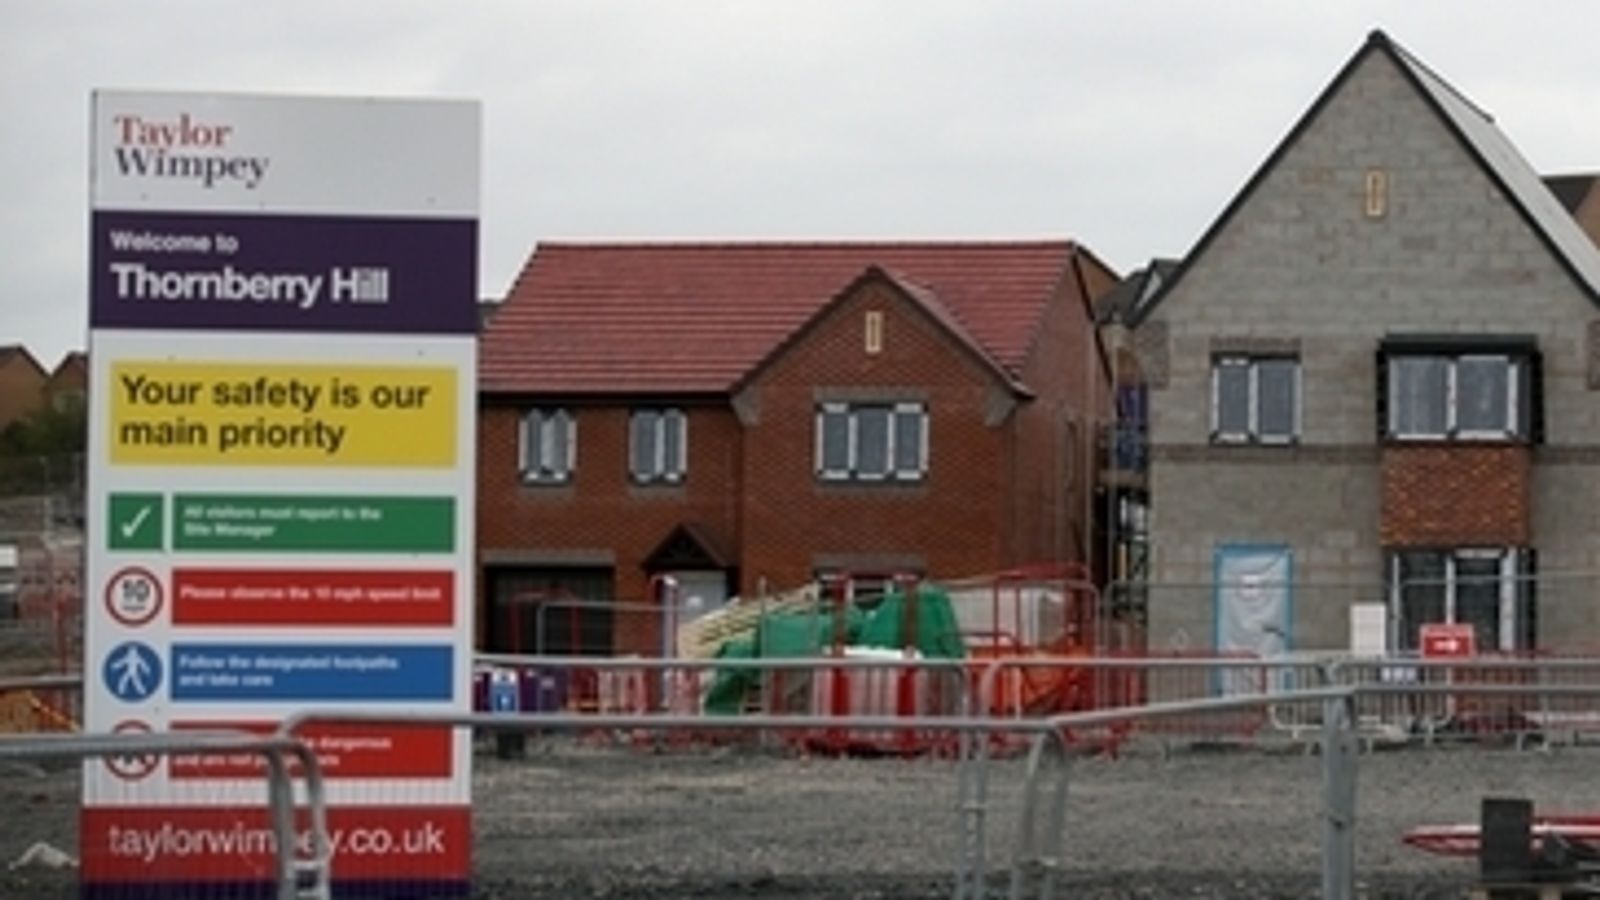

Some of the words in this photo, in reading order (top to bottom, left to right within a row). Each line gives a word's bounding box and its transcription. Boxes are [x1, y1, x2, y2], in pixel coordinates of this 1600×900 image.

[114, 113, 233, 150] Taylor
[114, 148, 269, 189] Wimpey
[109, 231, 211, 253] Welcome
[215, 235, 239, 254] to
[109, 263, 322, 308] Thornberry
[331, 268, 390, 302] Hill
[121, 375, 202, 405] Your
[211, 377, 322, 413] safety
[331, 379, 361, 408] is
[369, 385, 430, 409] our
[120, 417, 208, 446] main
[218, 419, 346, 453] priority
[179, 654, 226, 670] Follow
[227, 654, 250, 669] the
[108, 822, 446, 863] taylorwimey.co.uk
